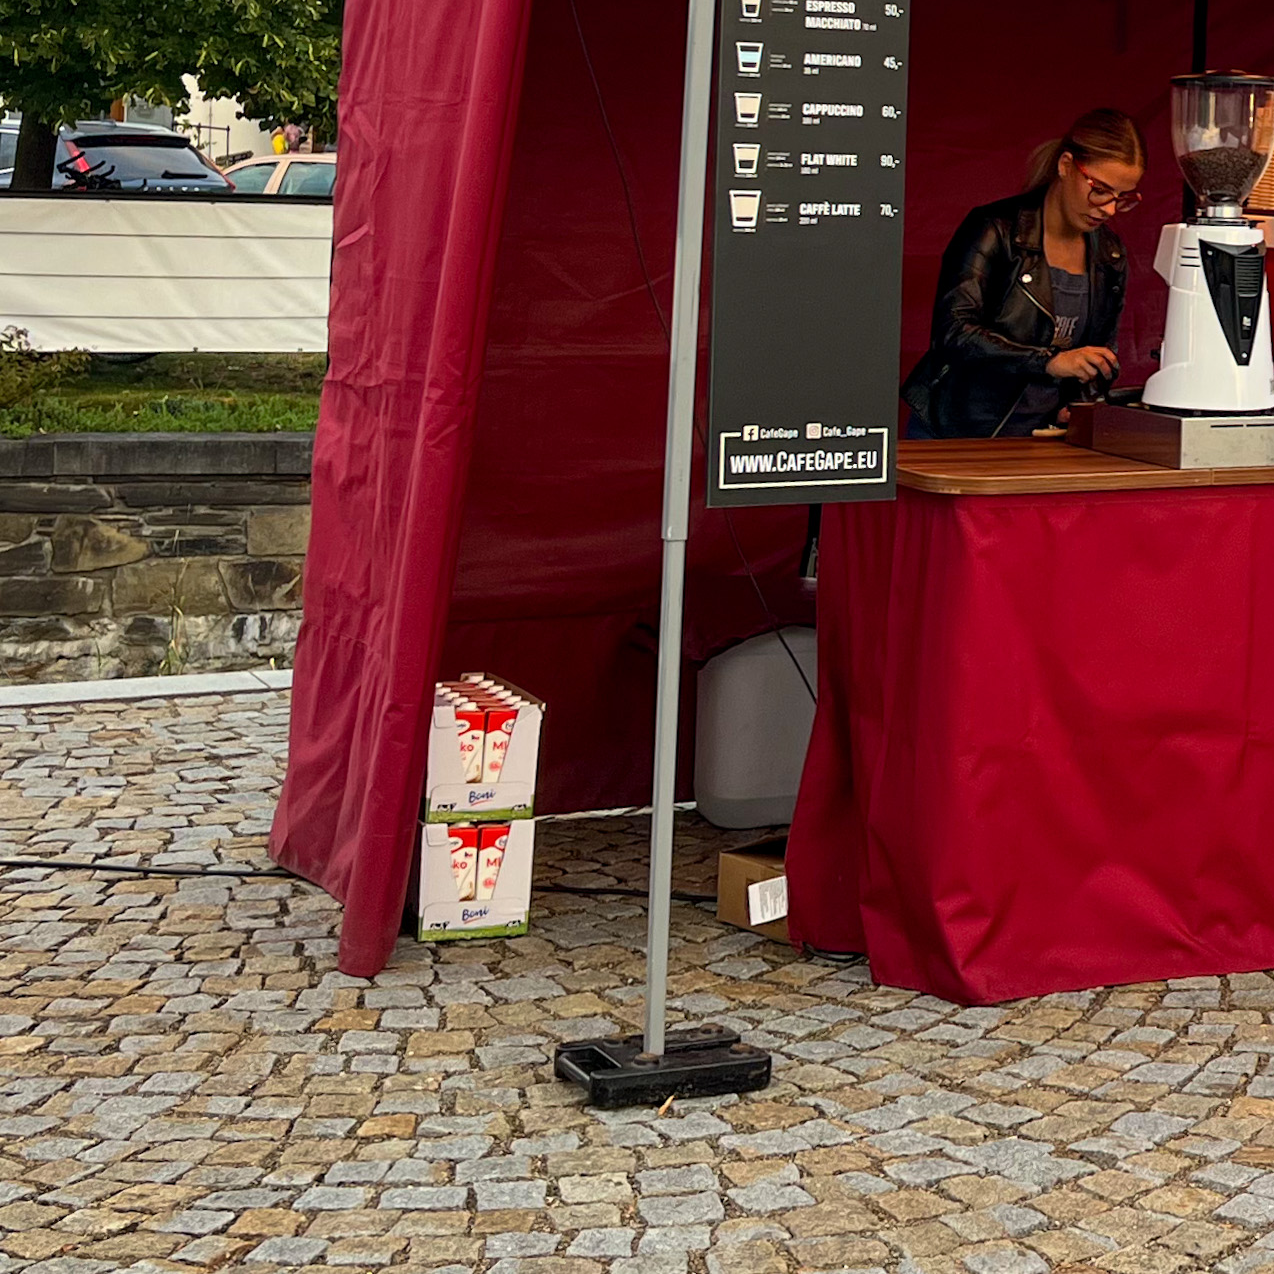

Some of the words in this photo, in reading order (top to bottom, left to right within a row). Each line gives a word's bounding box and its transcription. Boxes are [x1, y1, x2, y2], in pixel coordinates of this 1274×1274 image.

[805, 0, 856, 14] ESPRESSO
[805, 16, 862, 31] MACCHIATO
[803, 53, 862, 68] AMERICANO
[802, 103, 864, 118] CAPPUCCINO
[800, 153, 824, 166] FLAT
[825, 154, 858, 167] WHITE
[799, 201, 830, 216] CAFFÈ
[831, 204, 861, 216] LATTE
[759, 427, 799, 439] CafeGape
